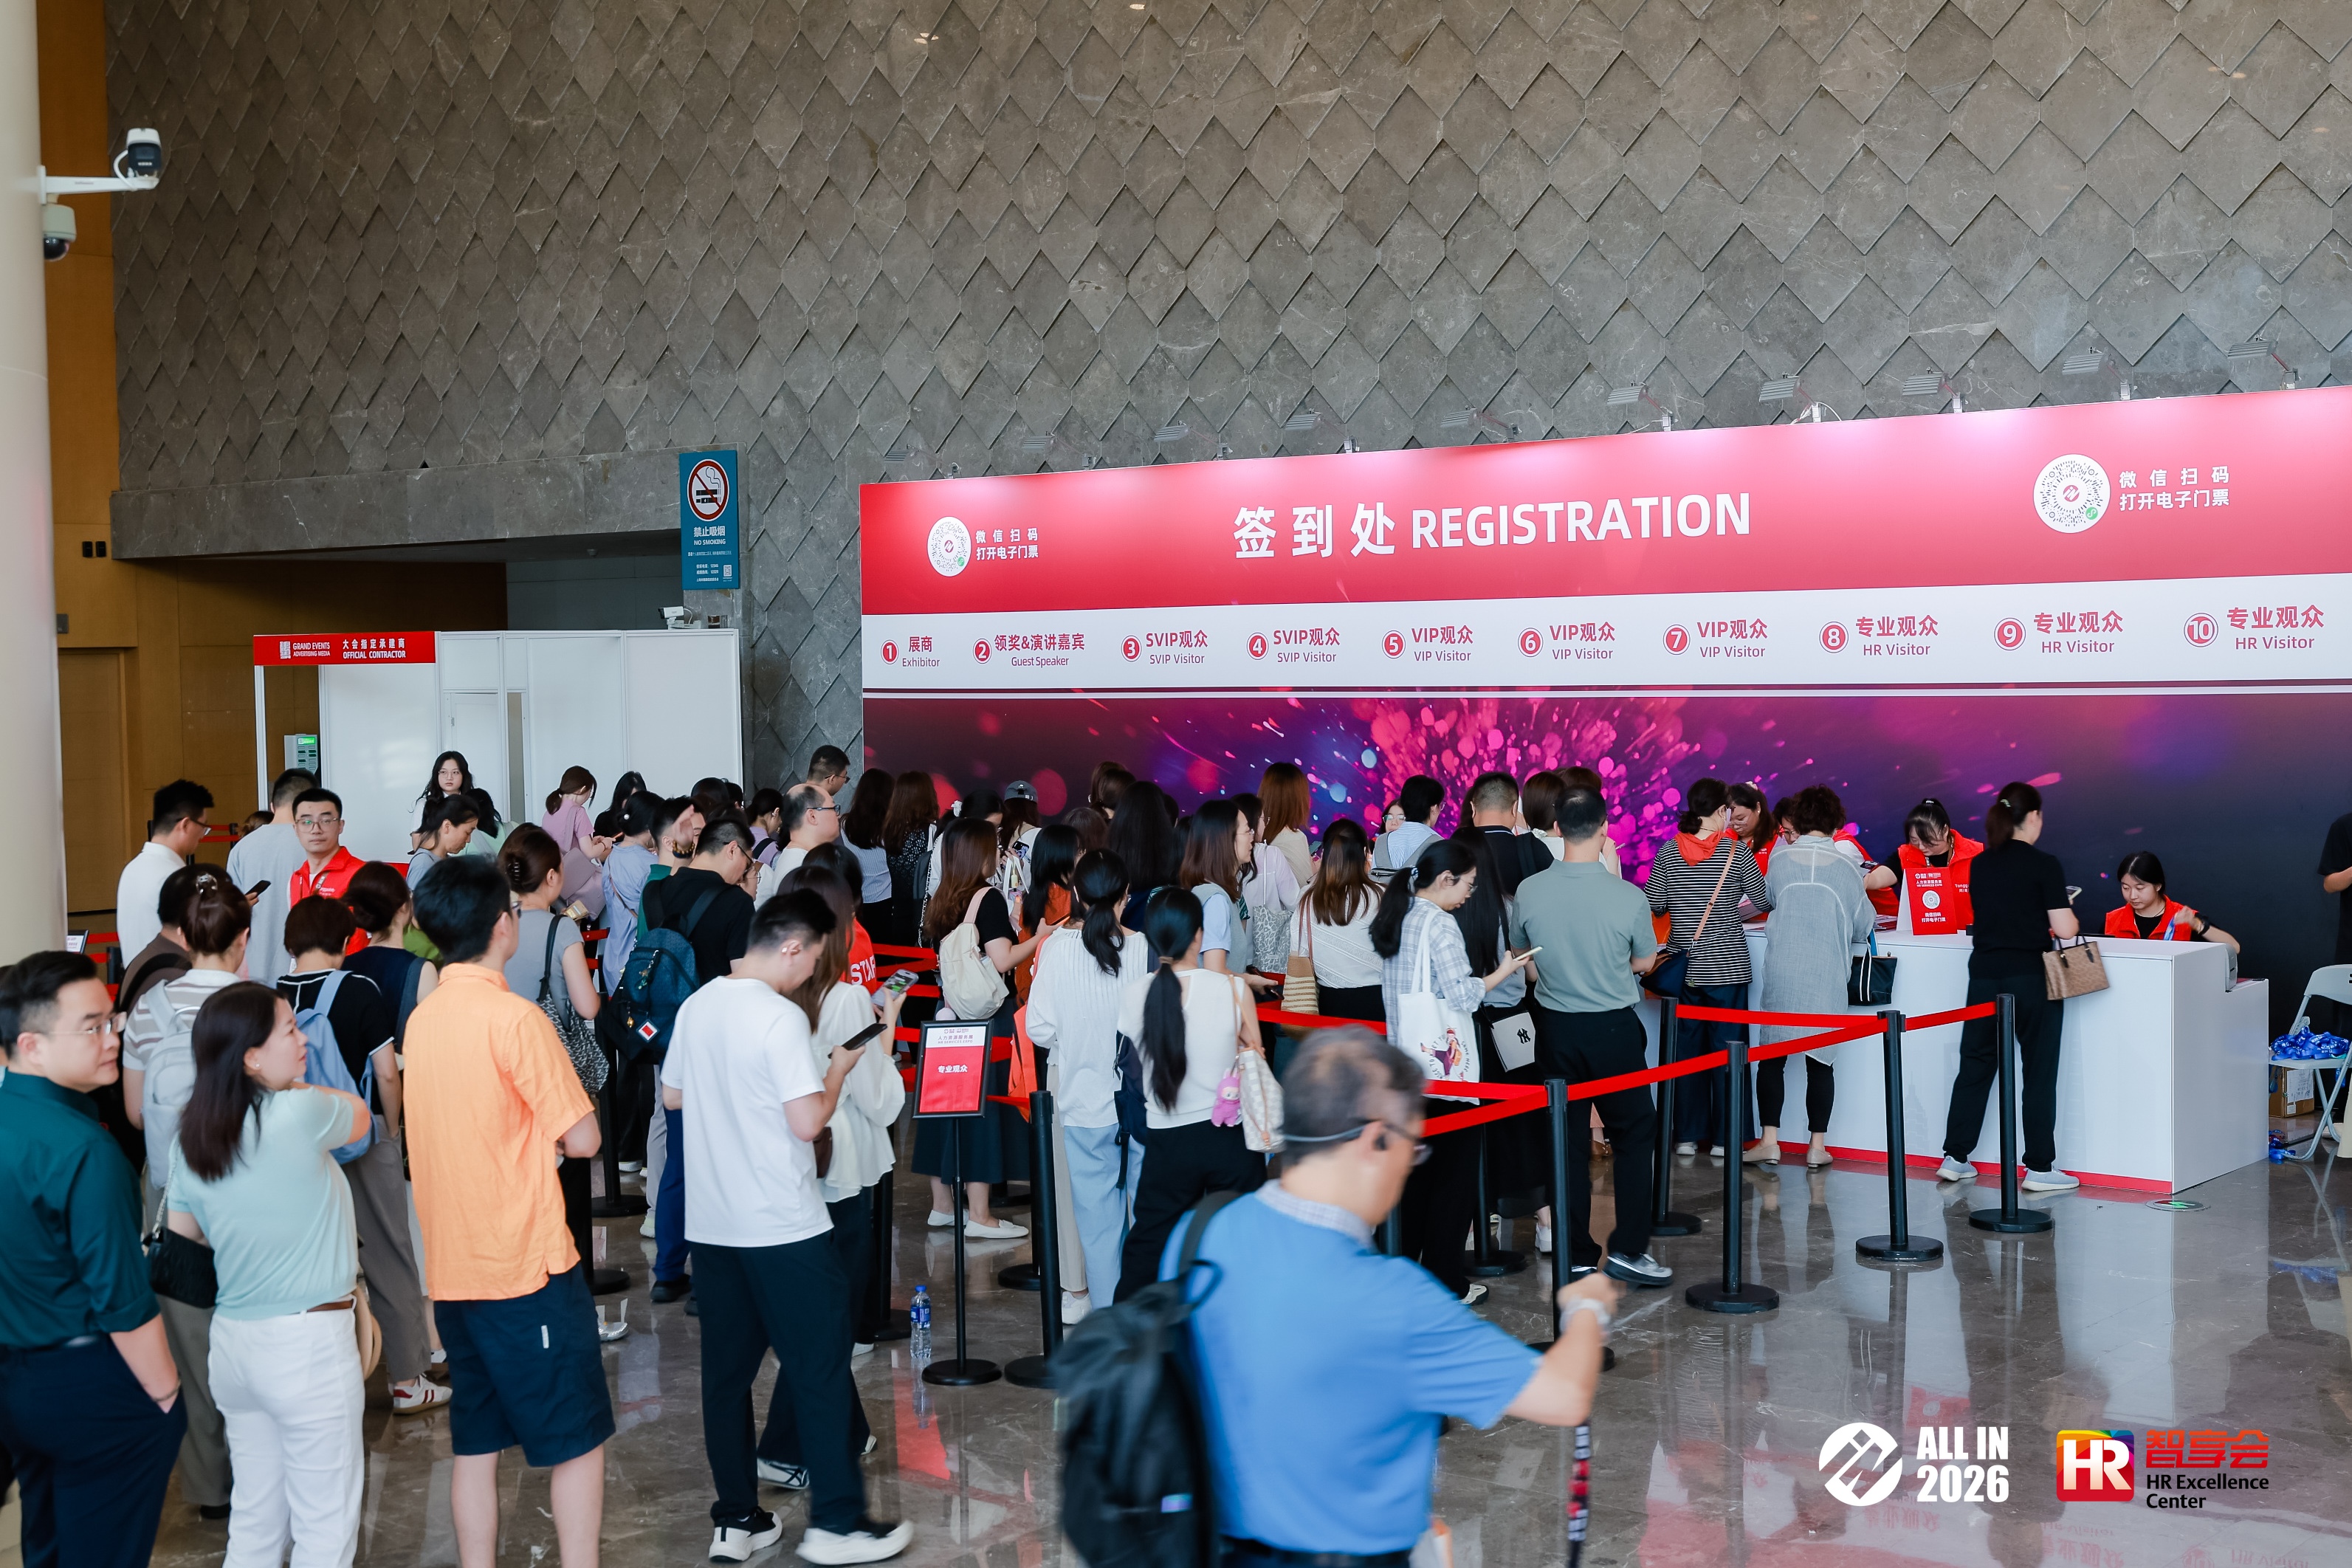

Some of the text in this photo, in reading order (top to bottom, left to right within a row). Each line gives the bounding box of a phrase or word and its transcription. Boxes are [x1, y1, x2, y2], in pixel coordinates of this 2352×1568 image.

[2119, 466, 2229, 489] 微信扫码
[2119, 488, 2229, 512] 打开电子门票
[694, 526, 726, 537] 禁止吸烟
[1232, 492, 1750, 559] 签到处 REGISTRATION
[976, 528, 1038, 543] 微信扫码
[976, 543, 1038, 560] 打开电子门票
[2034, 610, 2123, 633] 专业观众
[2227, 604, 2324, 630] 专业观众
[1550, 622, 1615, 642] VIP观众
[1697, 619, 1767, 639] VIP观众
[1855, 614, 1939, 638] 专业观众
[1146, 630, 1208, 650] SVIP观众
[1273, 627, 1341, 647] SVIP观众
[1411, 625, 1473, 644] VIP观众
[2235, 634, 2315, 650] HR Visitor
[343, 638, 405, 650] 大会指定承建商
[908, 636, 932, 653] 展商
[994, 633, 1084, 653] 领奖&演讲嘉宾
[1699, 644, 1765, 658] VIP Visitor
[1863, 642, 1930, 656] HR Visitor
[2041, 639, 2114, 653] HR Visitor
[343, 650, 406, 659] OFFICIAL CONTRACTOR
[1149, 653, 1205, 664] SVIP Visitor
[1277, 650, 1337, 663] SVIP Visitor
[1414, 649, 1471, 661] VIP Visitor
[1552, 647, 1613, 659] VIP Visitor
[902, 656, 940, 667] Exhibitor
[1011, 655, 1070, 668] Guest Speaker
[850, 955, 876, 985] STAF
[938, 1065, 968, 1073] 专业观众
